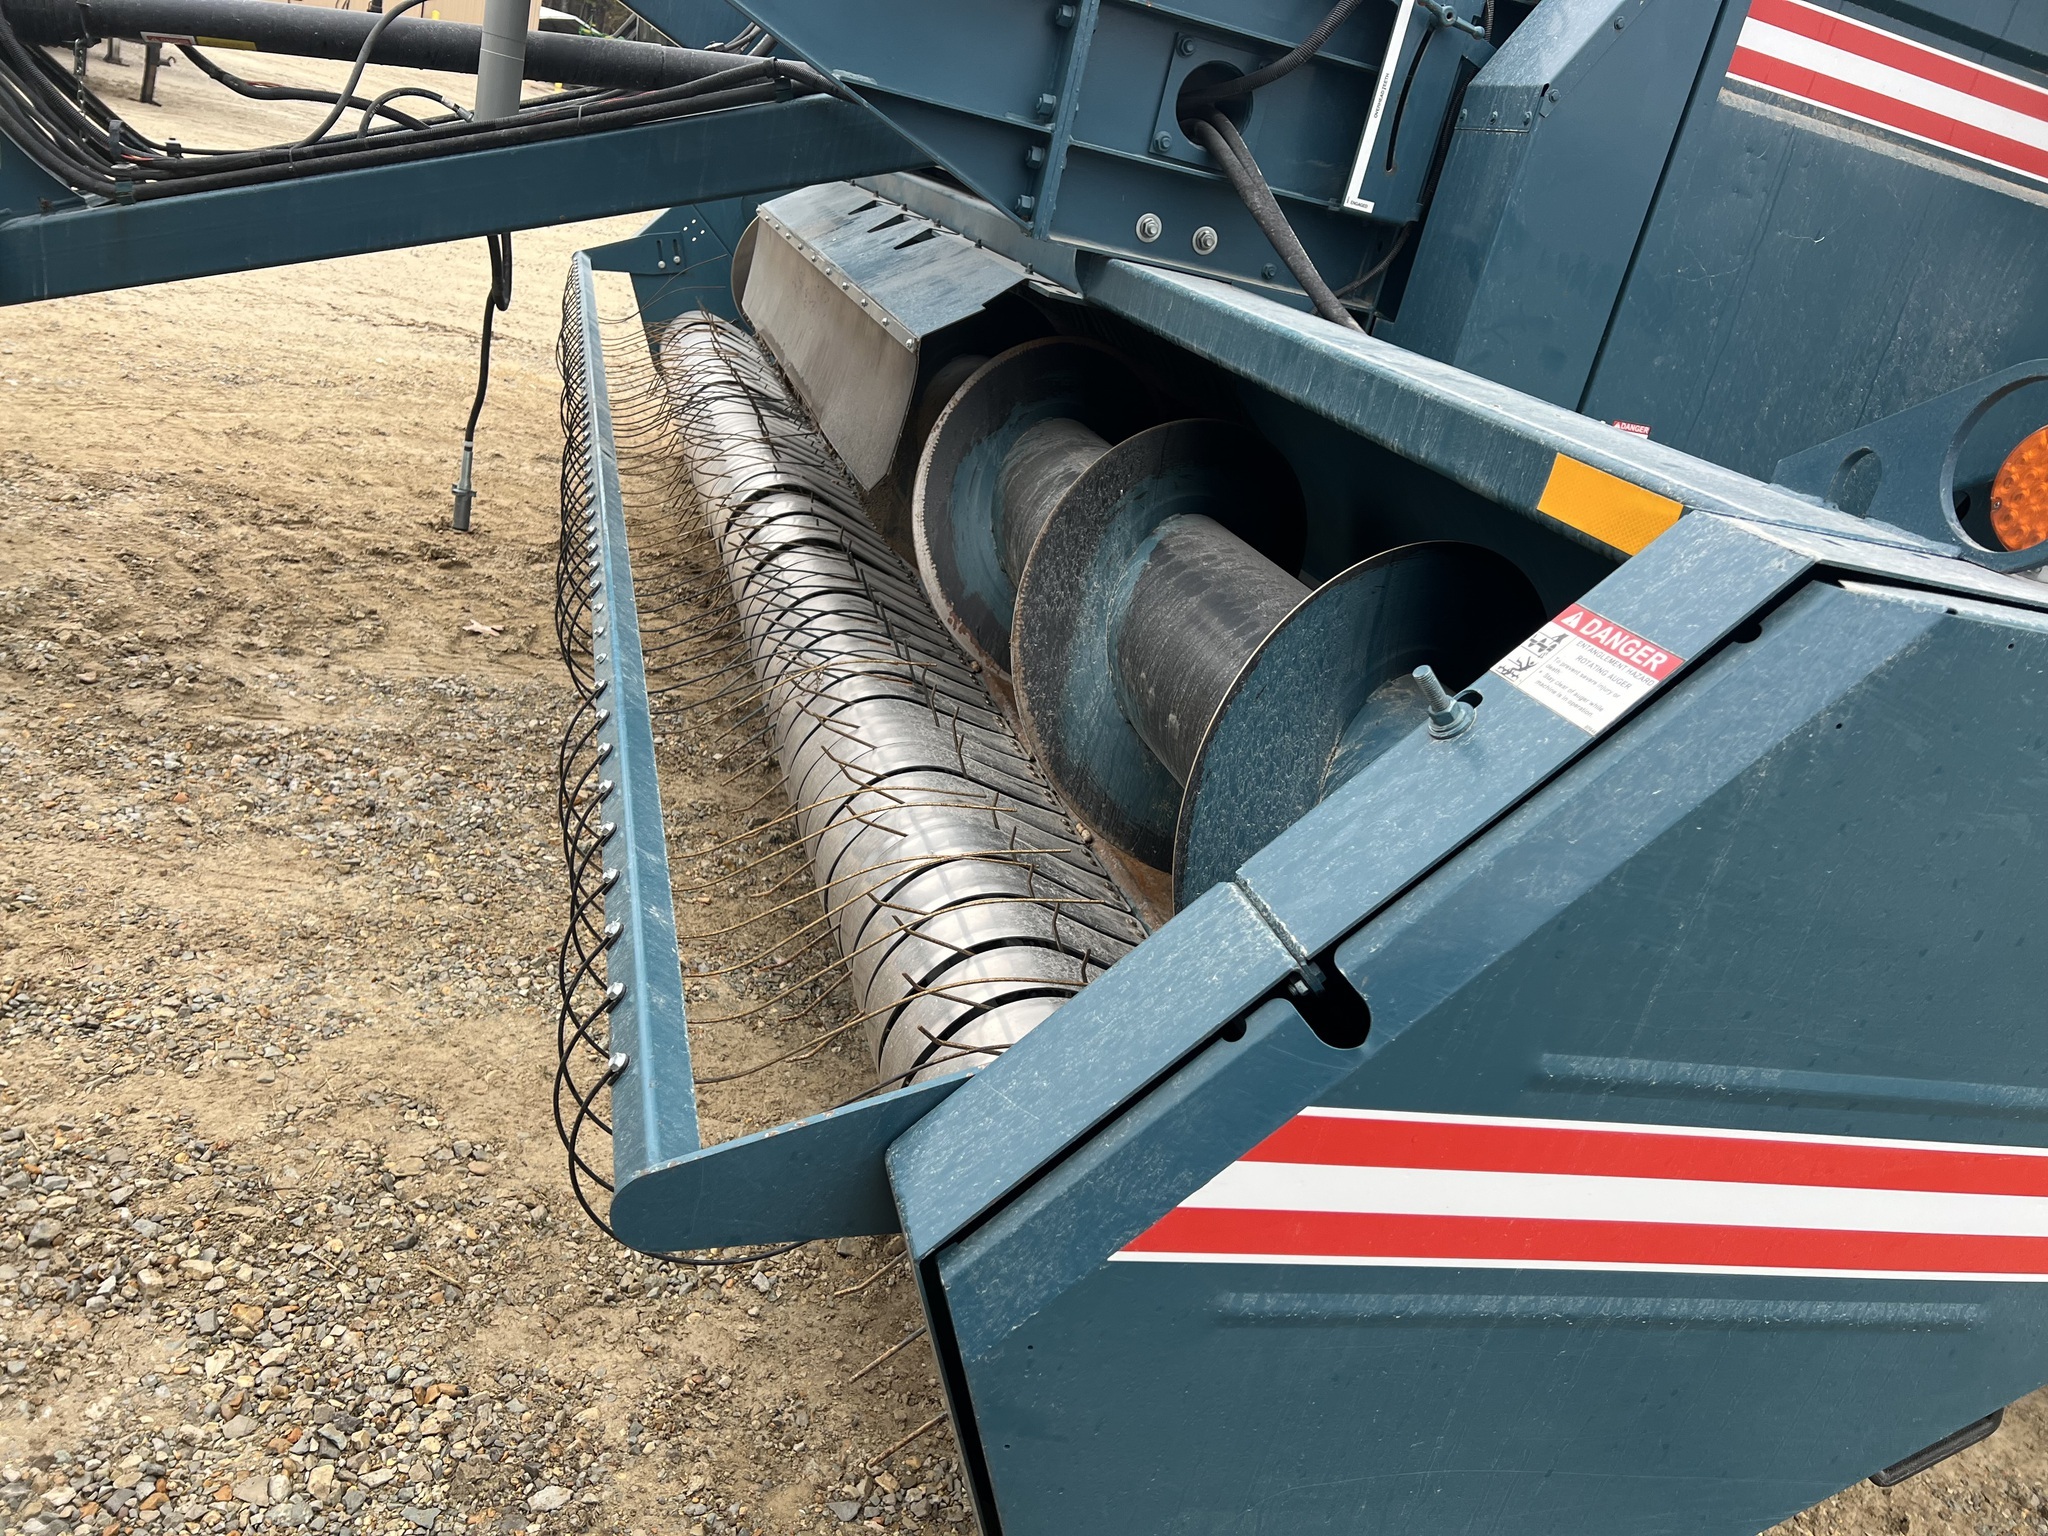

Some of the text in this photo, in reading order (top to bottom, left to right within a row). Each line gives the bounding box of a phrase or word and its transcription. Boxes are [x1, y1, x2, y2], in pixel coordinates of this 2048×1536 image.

[1374, 73, 1390, 118] OVERHEAD TEETH
[1350, 200, 1368, 209] ENGAGED
[1620, 422, 1650, 434] DANGER
[1579, 618, 1668, 672] DANGER
[1559, 662, 1580, 676] prevent
[1580, 673, 1597, 685] severe
[1597, 682, 1613, 695] injury
[1576, 641, 1655, 687] ENTANGLEMENT HAZARD
[1576, 655, 1632, 690] ROTATING AUGER
[1535, 680, 1557, 694] machine
[1543, 673, 1556, 683] Stay
[1554, 681, 1568, 690] clear
[1573, 692, 1589, 703] auger
[1589, 701, 1604, 712] while
